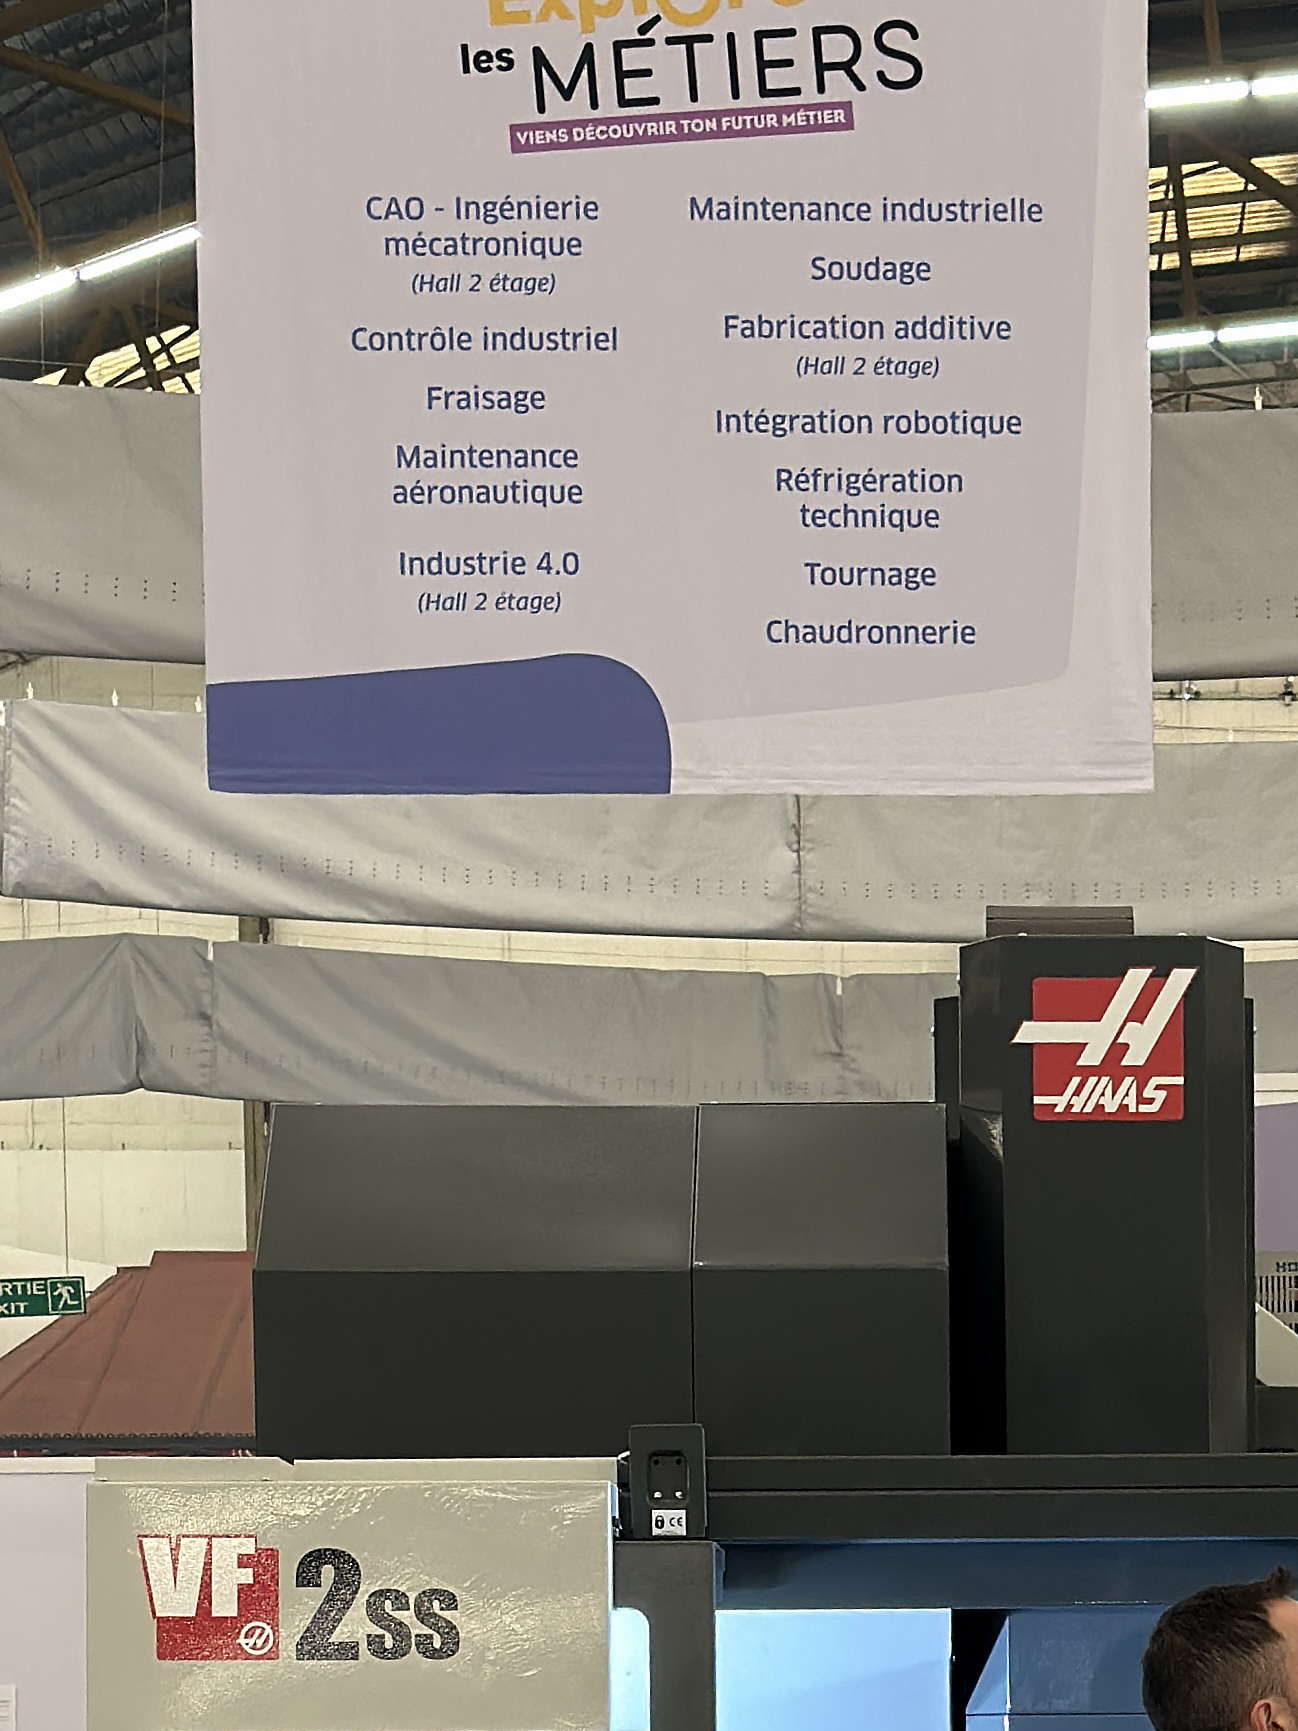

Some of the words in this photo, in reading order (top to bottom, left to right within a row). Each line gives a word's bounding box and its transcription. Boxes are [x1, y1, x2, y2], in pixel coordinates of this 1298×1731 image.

[460, 43, 515, 75] les
[531, 13, 923, 115] MÉTIERS
[516, 129, 569, 145] VIENS
[573, 121, 678, 142] DÉCOUVRIR
[681, 117, 717, 134] TON
[722, 113, 779, 131] FUTUR
[781, 108, 847, 127] MÉTIER
[366, 196, 425, 221] CAO
[455, 194, 599, 225] Ingénierie
[689, 195, 871, 222] Maintenance
[882, 196, 1044, 223] industrielle
[384, 231, 583, 260] mécatronique
[411, 273, 461, 295] (Hall
[468, 273, 482, 292] 2
[489, 272, 556, 295] étage)
[811, 255, 932, 286] Soudage
[351, 326, 472, 352] Contrôle
[483, 326, 618, 352] industriel
[723, 314, 885, 340] Fabrication
[894, 314, 1013, 341] additive
[796, 356, 845, 378] (Hall
[852, 357, 866, 376] 2
[873, 355, 940, 379] étage)
[426, 385, 546, 415] Fraisage
[716, 409, 873, 438] Intégration
[883, 410, 1023, 439] robotique
[396, 444, 579, 469] Maintenance
[392, 479, 584, 508] aéronautique
[775, 467, 964, 496] Réfrigération
[800, 503, 940, 532] technique
[399, 550, 527, 576] Industrie
[536, 552, 580, 576] 4.0
[804, 562, 937, 591] Tournage
[418, 591, 467, 613] (Hall
[474, 592, 488, 611] 2
[494, 591, 562, 614] étage)
[766, 618, 977, 645] Chaudronnerie
[1033, 1076, 1185, 1114] HAAS
[140, 1535, 256, 1618] VF
